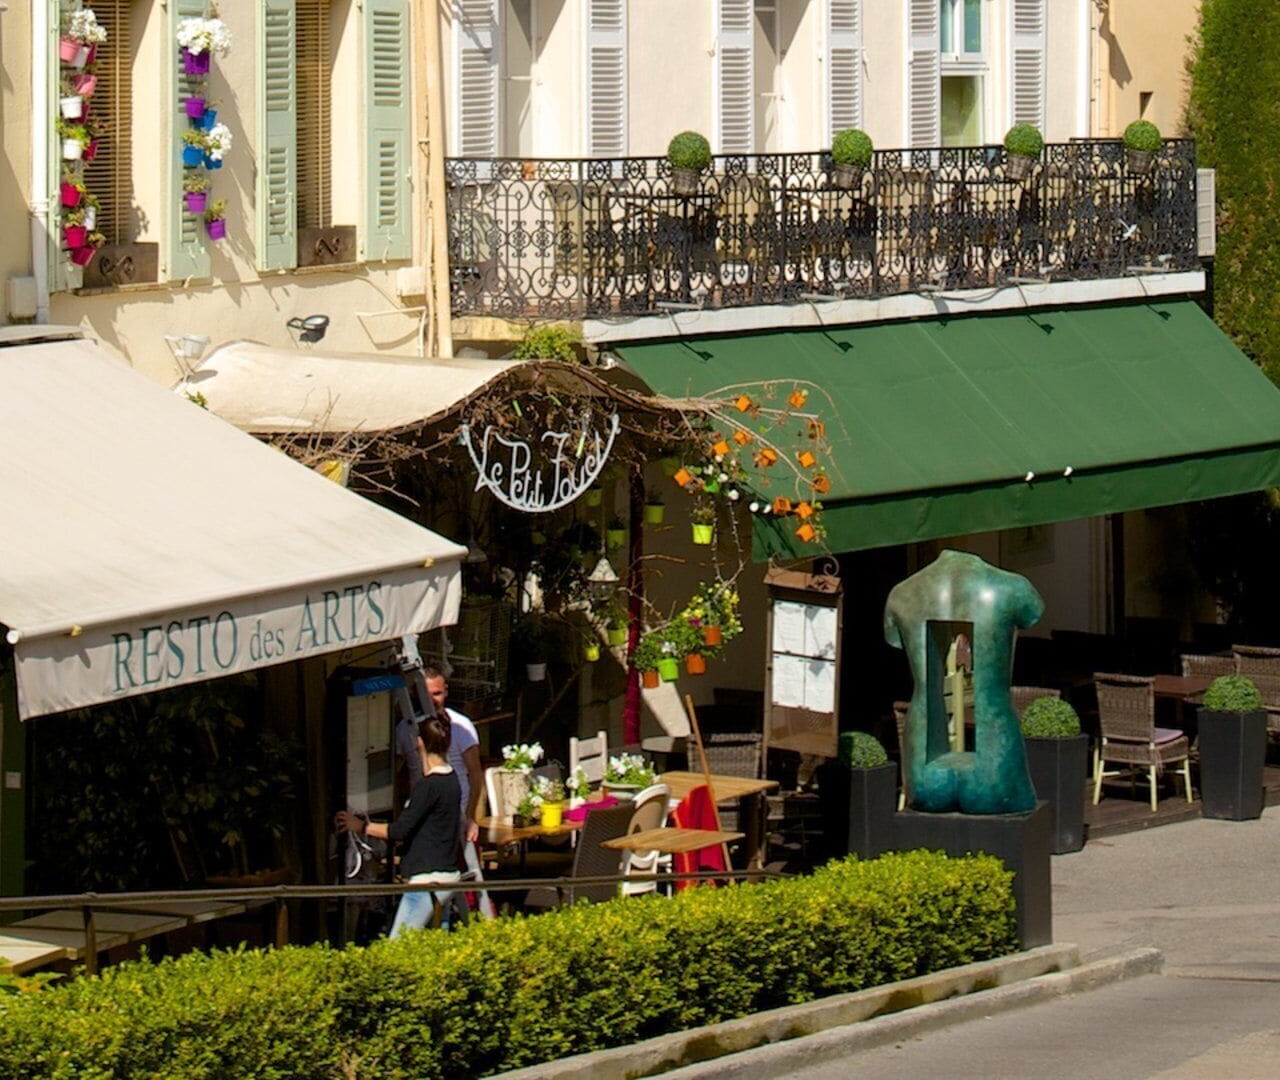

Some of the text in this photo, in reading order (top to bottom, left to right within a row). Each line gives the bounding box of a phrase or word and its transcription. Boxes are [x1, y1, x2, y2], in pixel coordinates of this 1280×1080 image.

[111, 580, 386, 693] RESTO des ARTS
